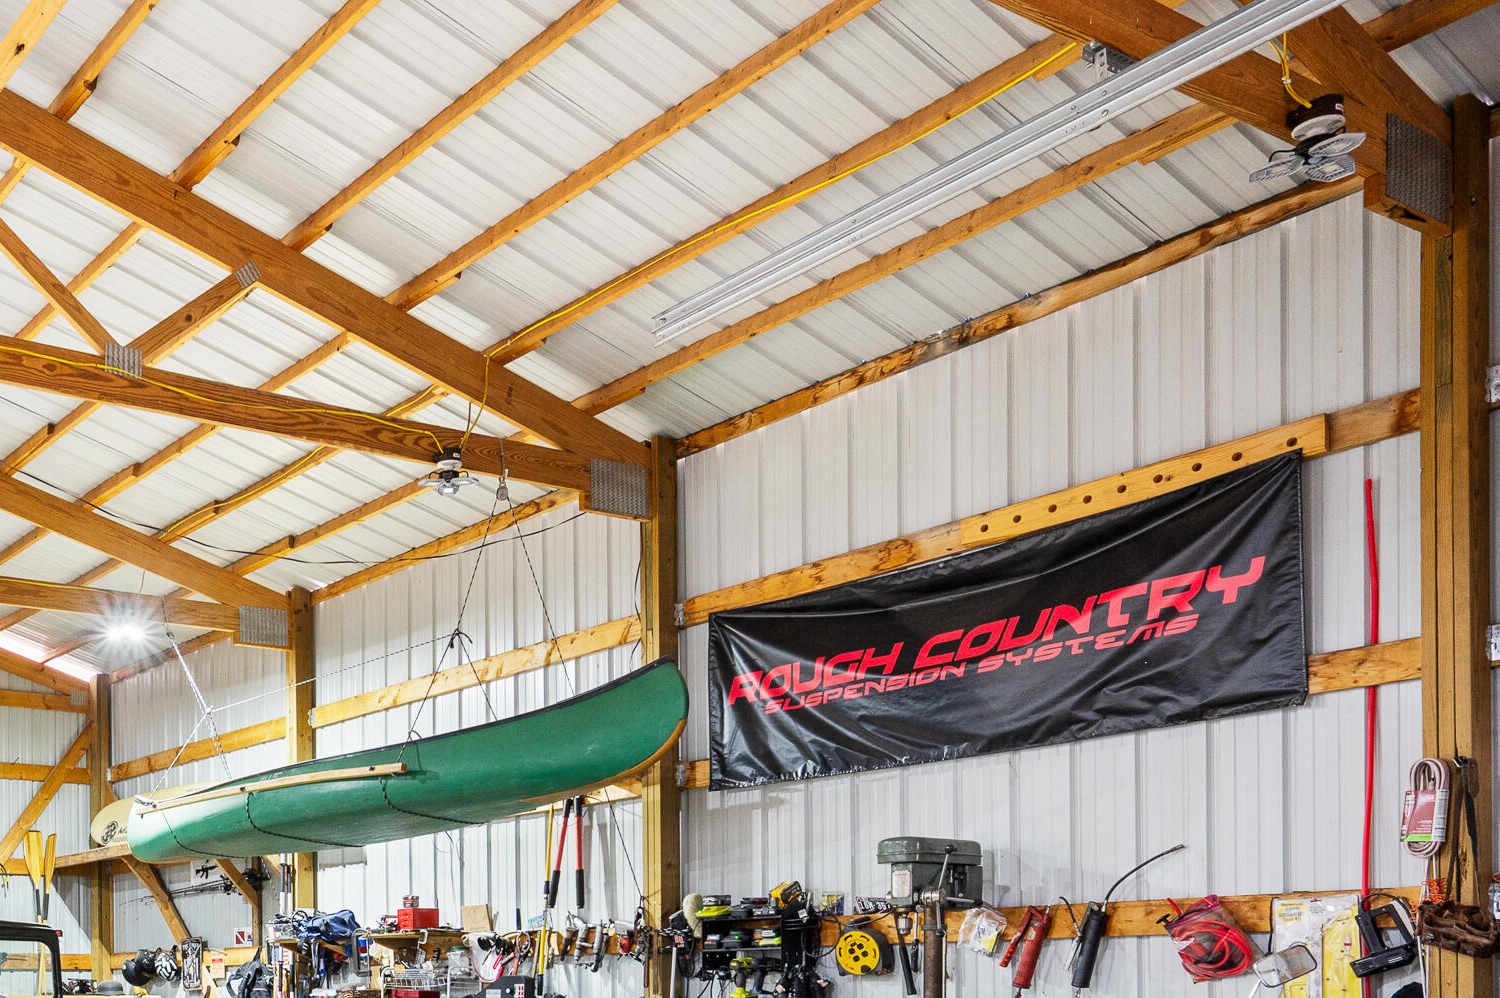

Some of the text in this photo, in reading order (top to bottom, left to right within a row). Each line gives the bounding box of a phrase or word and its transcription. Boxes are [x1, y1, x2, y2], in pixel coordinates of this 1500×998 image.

[727, 555, 1266, 706] ROUGH COUNTRY
[765, 613, 1199, 715] SUSPENSION SYSTEMS
